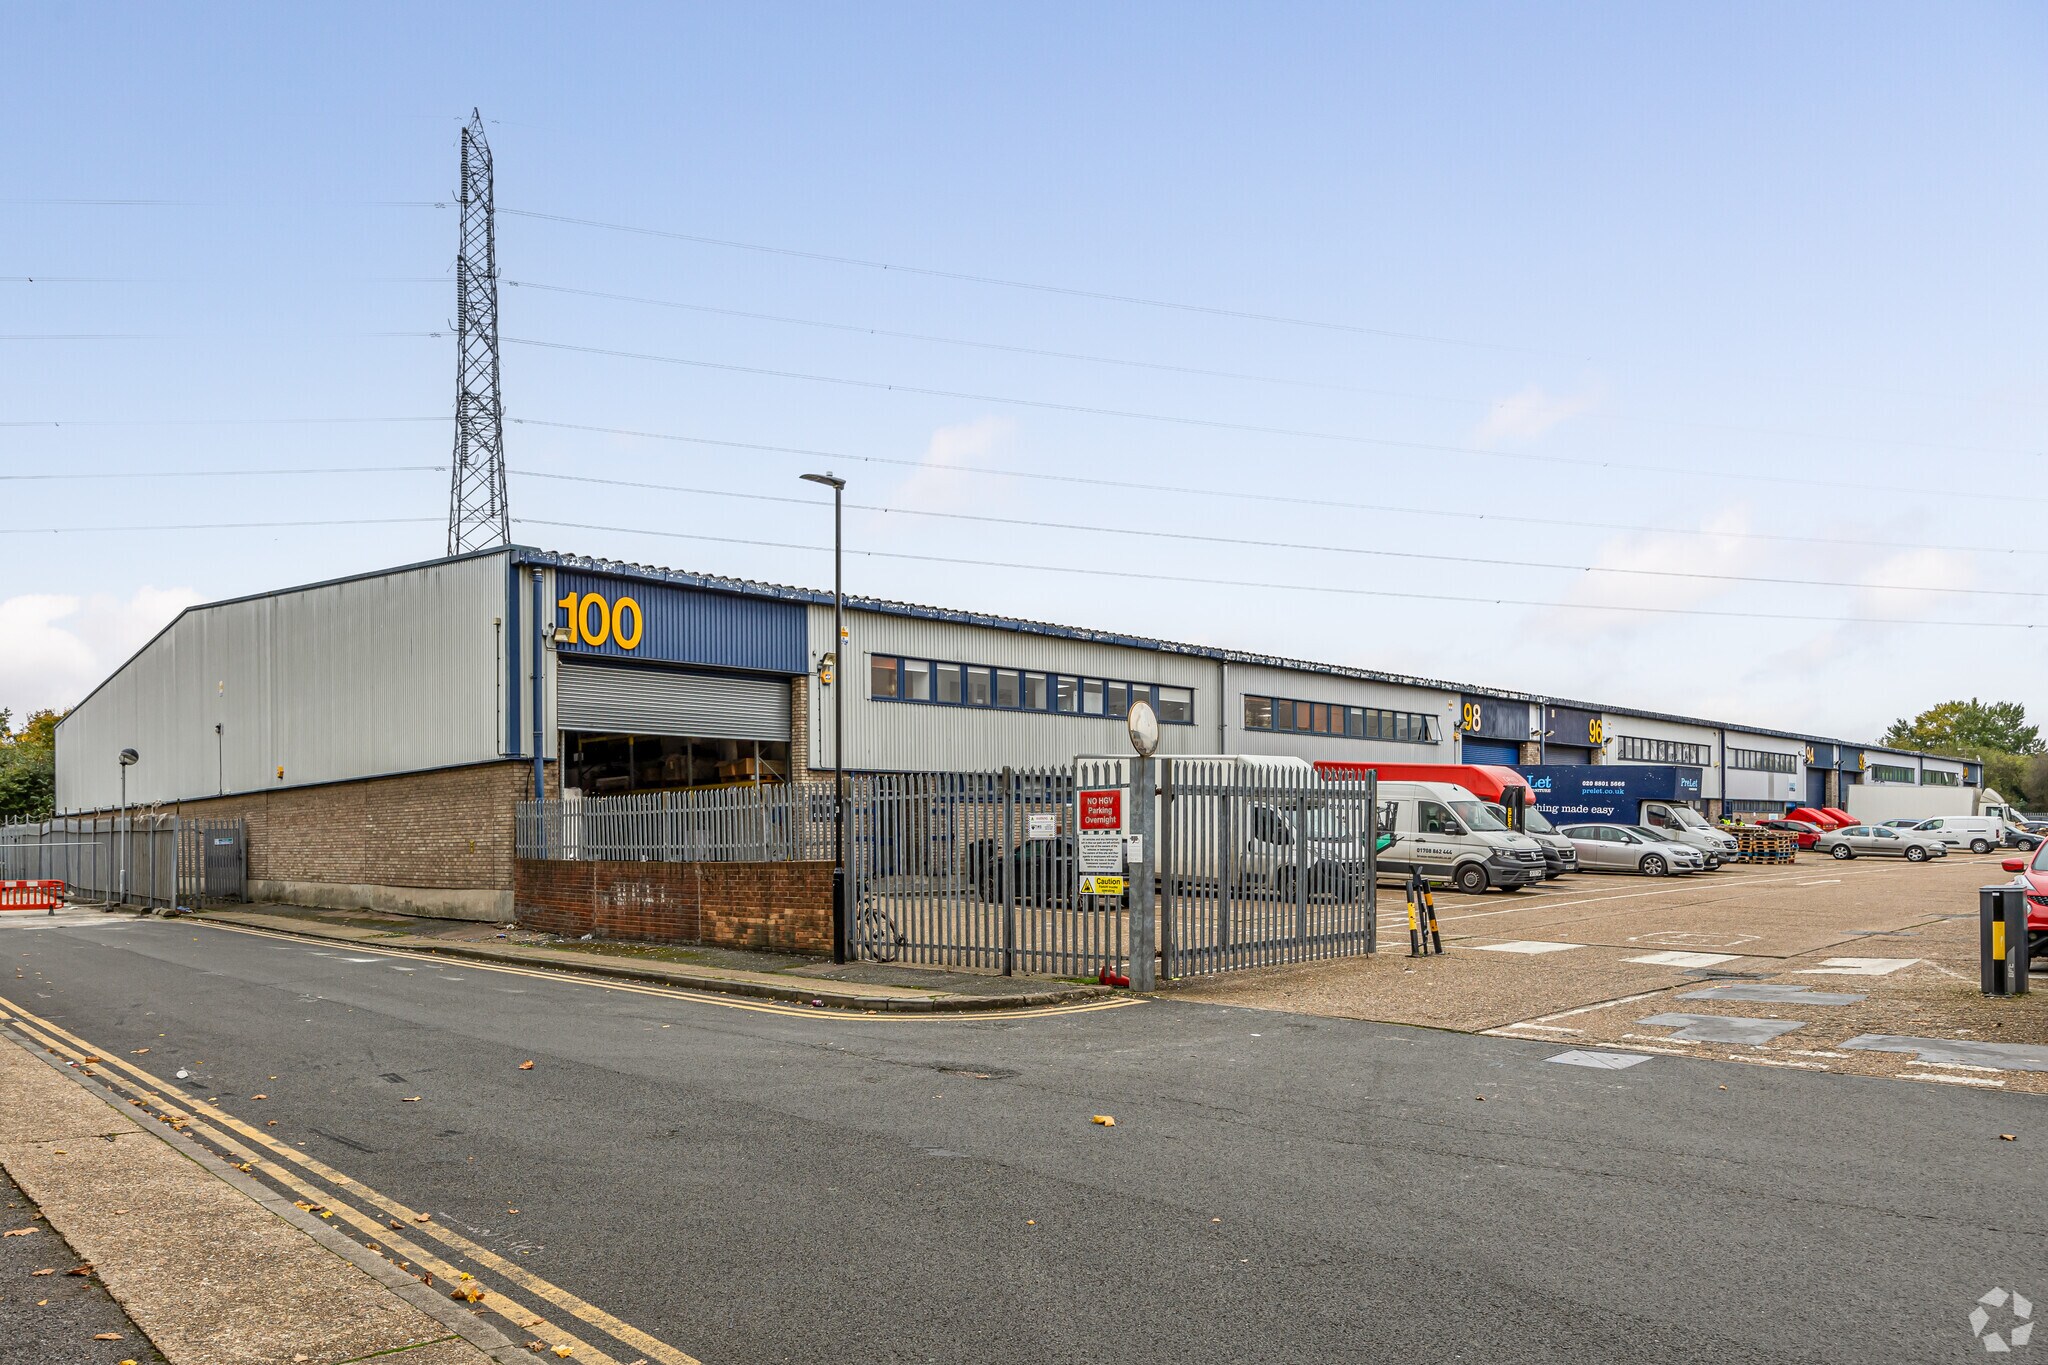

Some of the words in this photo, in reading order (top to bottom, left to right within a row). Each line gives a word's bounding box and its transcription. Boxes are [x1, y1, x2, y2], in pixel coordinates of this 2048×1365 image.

[558, 591, 643, 650] 100
[1463, 703, 1482, 732] 98
[1589, 718, 1603, 744] 96
[1087, 797, 1098, 805] NO
[1098, 796, 1114, 805] HGV
[1088, 806, 1113, 815] Parking
[1561, 804, 1589, 813] made
[1591, 806, 1615, 816] easy
[1084, 815, 1117, 825] Overnight
[1096, 877, 1121, 885] Caution
